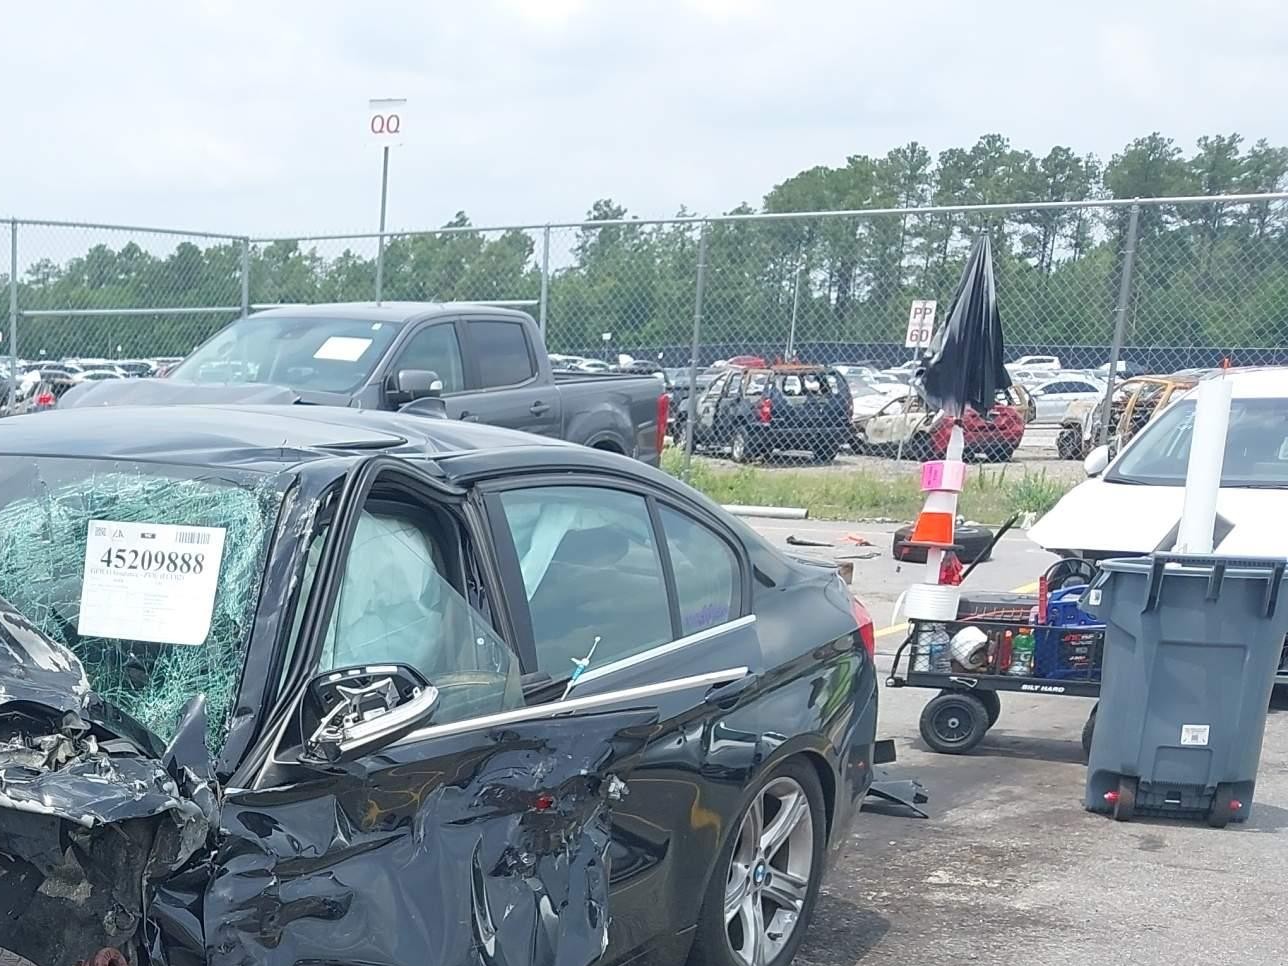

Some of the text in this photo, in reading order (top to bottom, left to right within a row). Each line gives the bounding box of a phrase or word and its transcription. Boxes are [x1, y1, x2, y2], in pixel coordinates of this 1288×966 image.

[371, 114, 400, 134] QQ
[913, 307, 932, 320] PP
[909, 329, 929, 342] 60
[100, 547, 205, 575] 45209888
